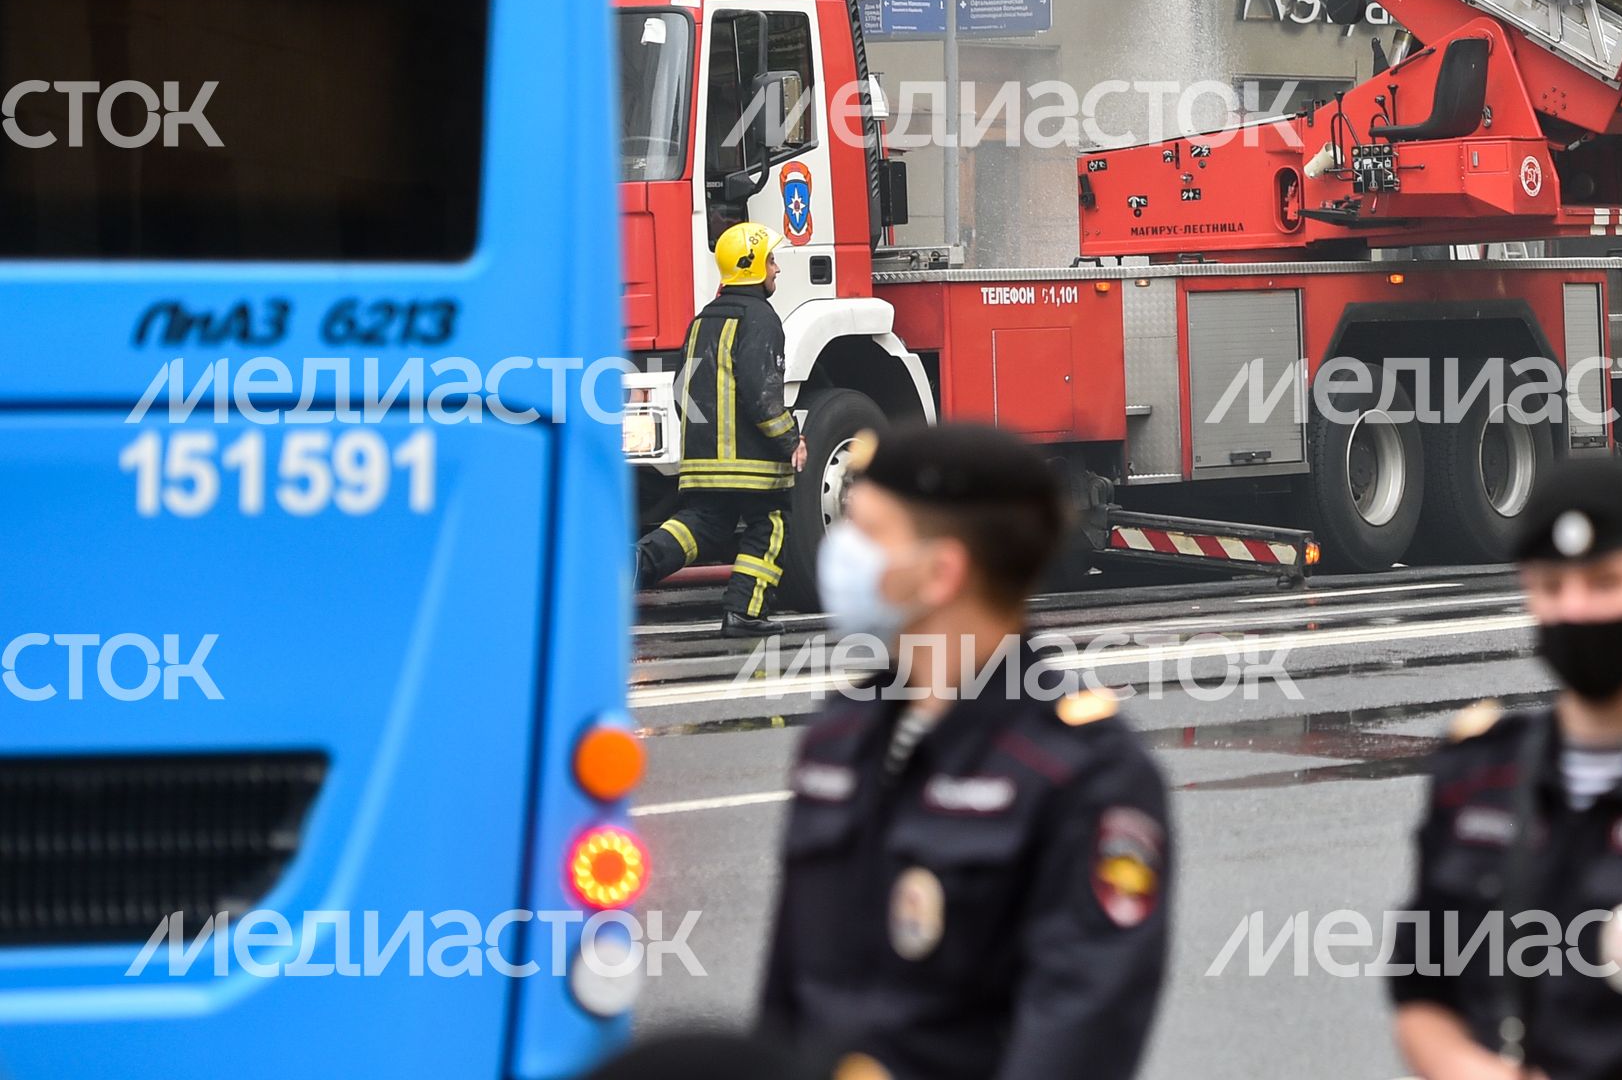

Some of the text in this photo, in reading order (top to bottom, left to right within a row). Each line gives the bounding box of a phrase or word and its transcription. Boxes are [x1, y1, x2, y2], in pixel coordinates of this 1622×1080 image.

[1130, 222, 1245, 237] МАГИРУС-ЛЕСТНИЦА
[980, 286, 1035, 305] ТЕЛЕФОН
[319, 298, 462, 347] 6213
[119, 428, 437, 517] 151591
